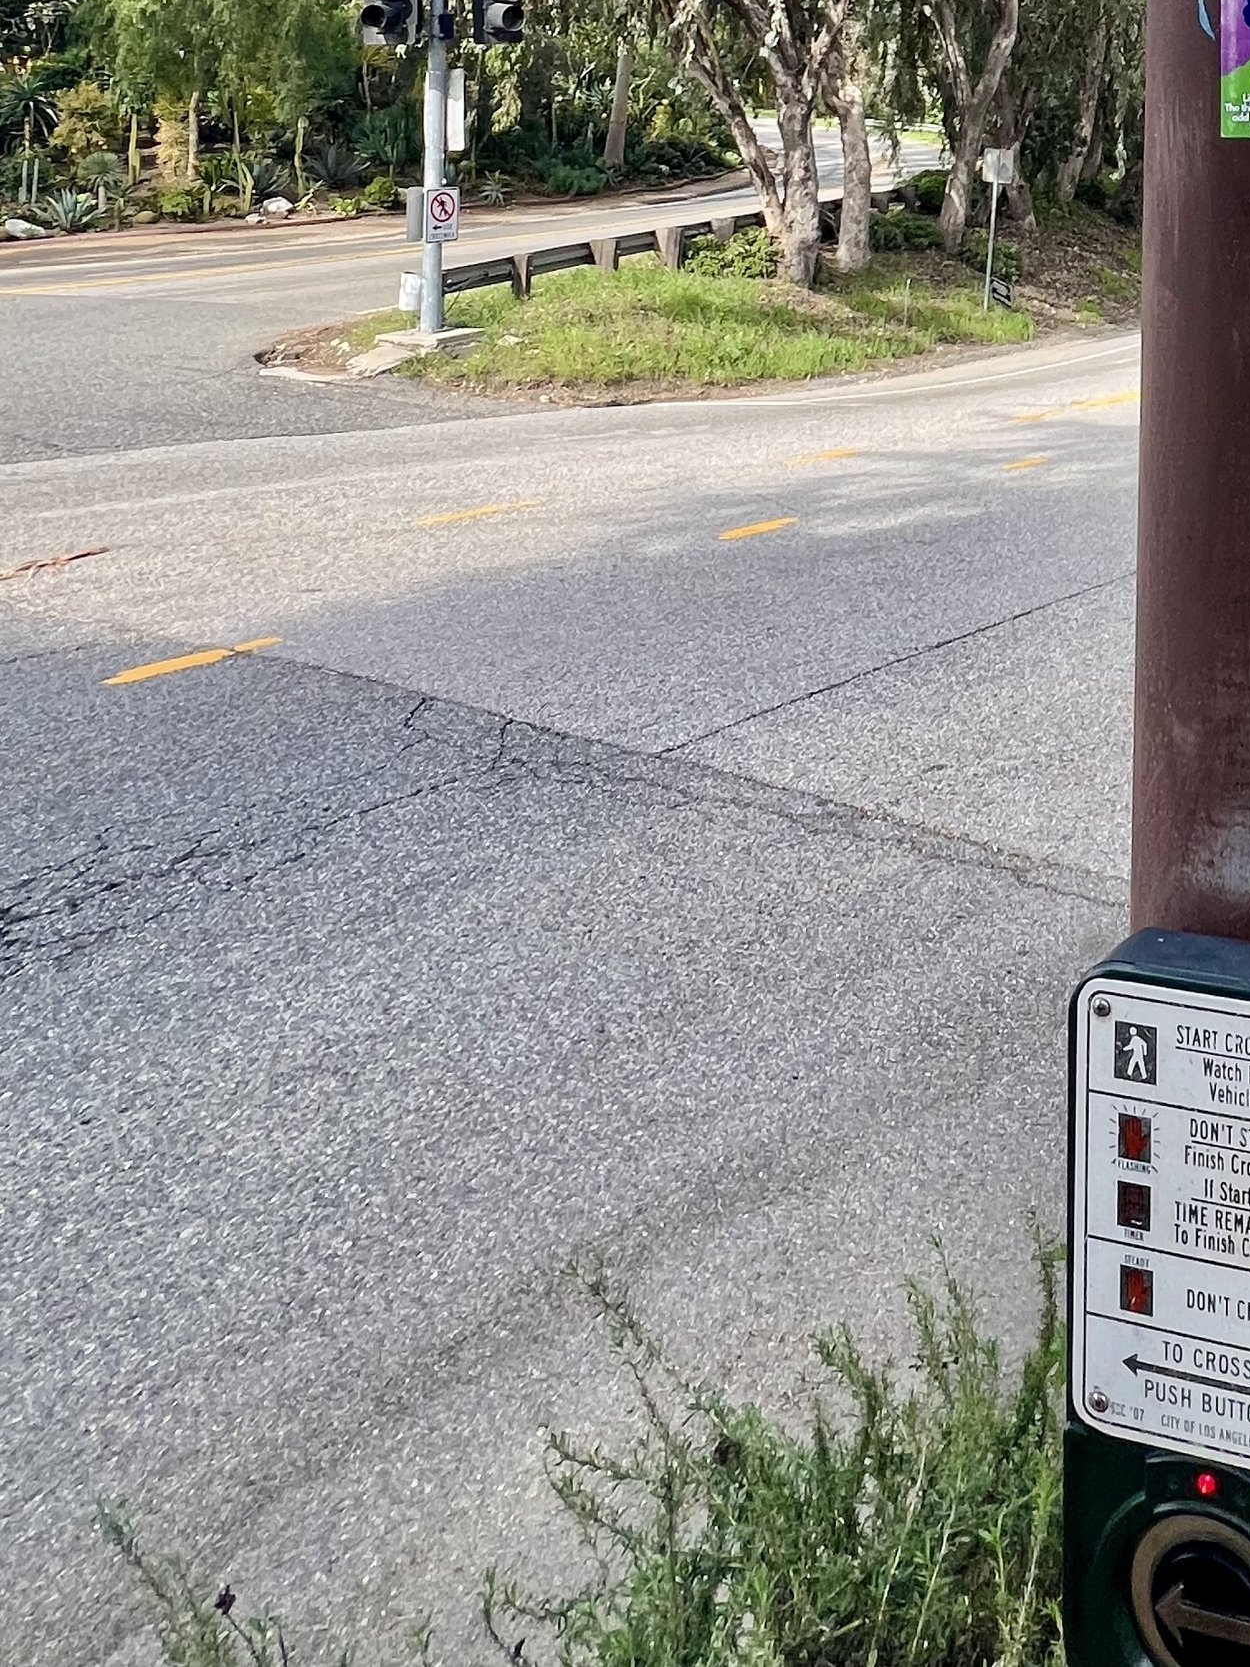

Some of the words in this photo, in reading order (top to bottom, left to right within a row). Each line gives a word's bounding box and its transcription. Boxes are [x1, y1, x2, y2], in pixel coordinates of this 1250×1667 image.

[1225, 103, 1240, 112] The
[1231, 112, 1249, 122] add
[1176, 1025, 1218, 1050] START
[1203, 1057, 1242, 1082] Watch
[1190, 1118, 1233, 1145] DON'T
[1118, 1161, 1151, 1174] FLASHING
[1184, 1145, 1224, 1171] Finish
[1204, 1178, 1214, 1199] If
[1175, 1201, 1208, 1226] TIME
[1124, 1228, 1144, 1241] TIMER
[1174, 1223, 1188, 1245] To
[1195, 1228, 1235, 1254] Finish
[1124, 1255, 1149, 1268] STEADY
[1187, 1289, 1231, 1316] DON'T
[1162, 1341, 1183, 1363] TO
[1144, 1379, 1191, 1409] PUSH
[1161, 1414, 1180, 1429] CITY
[1184, 1420, 1195, 1433] OF
[1199, 1423, 1215, 1439] LOS
